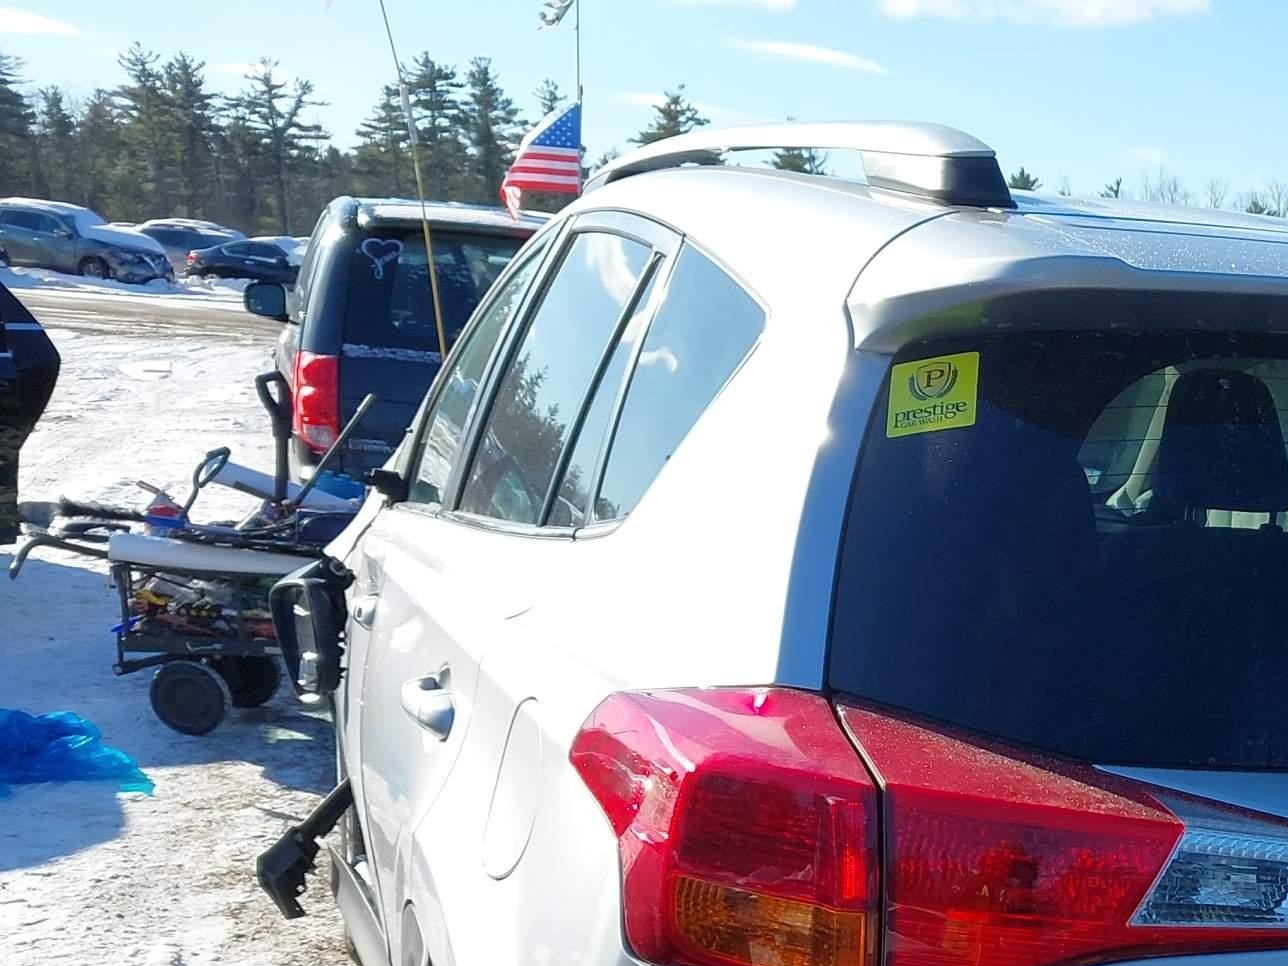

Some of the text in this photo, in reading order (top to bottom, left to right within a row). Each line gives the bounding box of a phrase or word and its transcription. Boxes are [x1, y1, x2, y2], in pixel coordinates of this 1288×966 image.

[923, 368, 945, 388] P
[893, 401, 968, 429] prestige
[900, 416, 944, 429] CAR WASH
